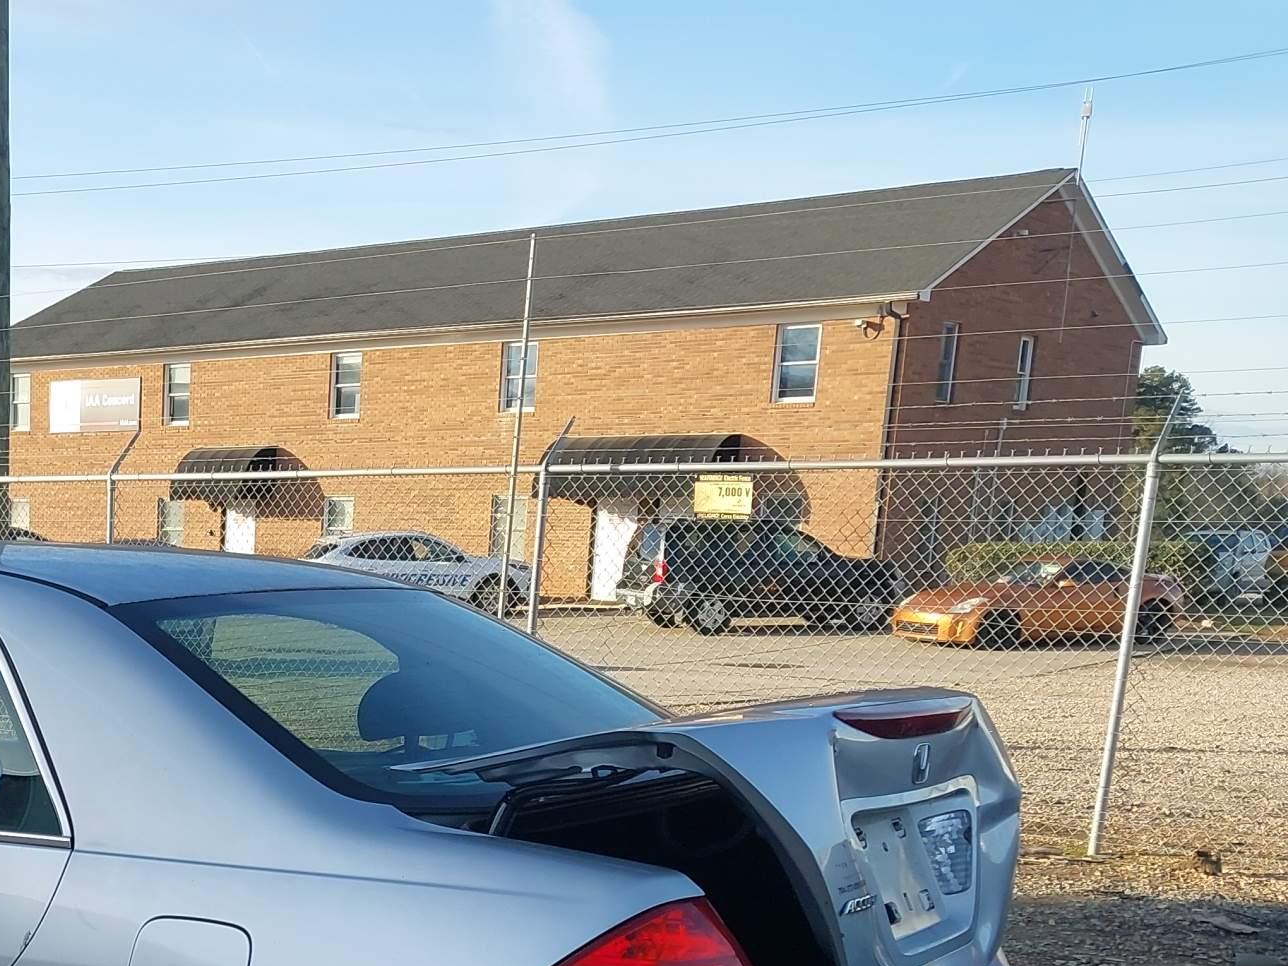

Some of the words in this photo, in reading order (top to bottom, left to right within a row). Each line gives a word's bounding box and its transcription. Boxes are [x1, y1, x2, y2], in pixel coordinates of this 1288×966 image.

[86, 393, 100, 406] IAA
[102, 393, 135, 406] Concord
[718, 487, 743, 498] 7,000
[745, 487, 751, 497] V
[381, 572, 472, 587] OGRESSIVE
[842, 894, 877, 916] ACCO
